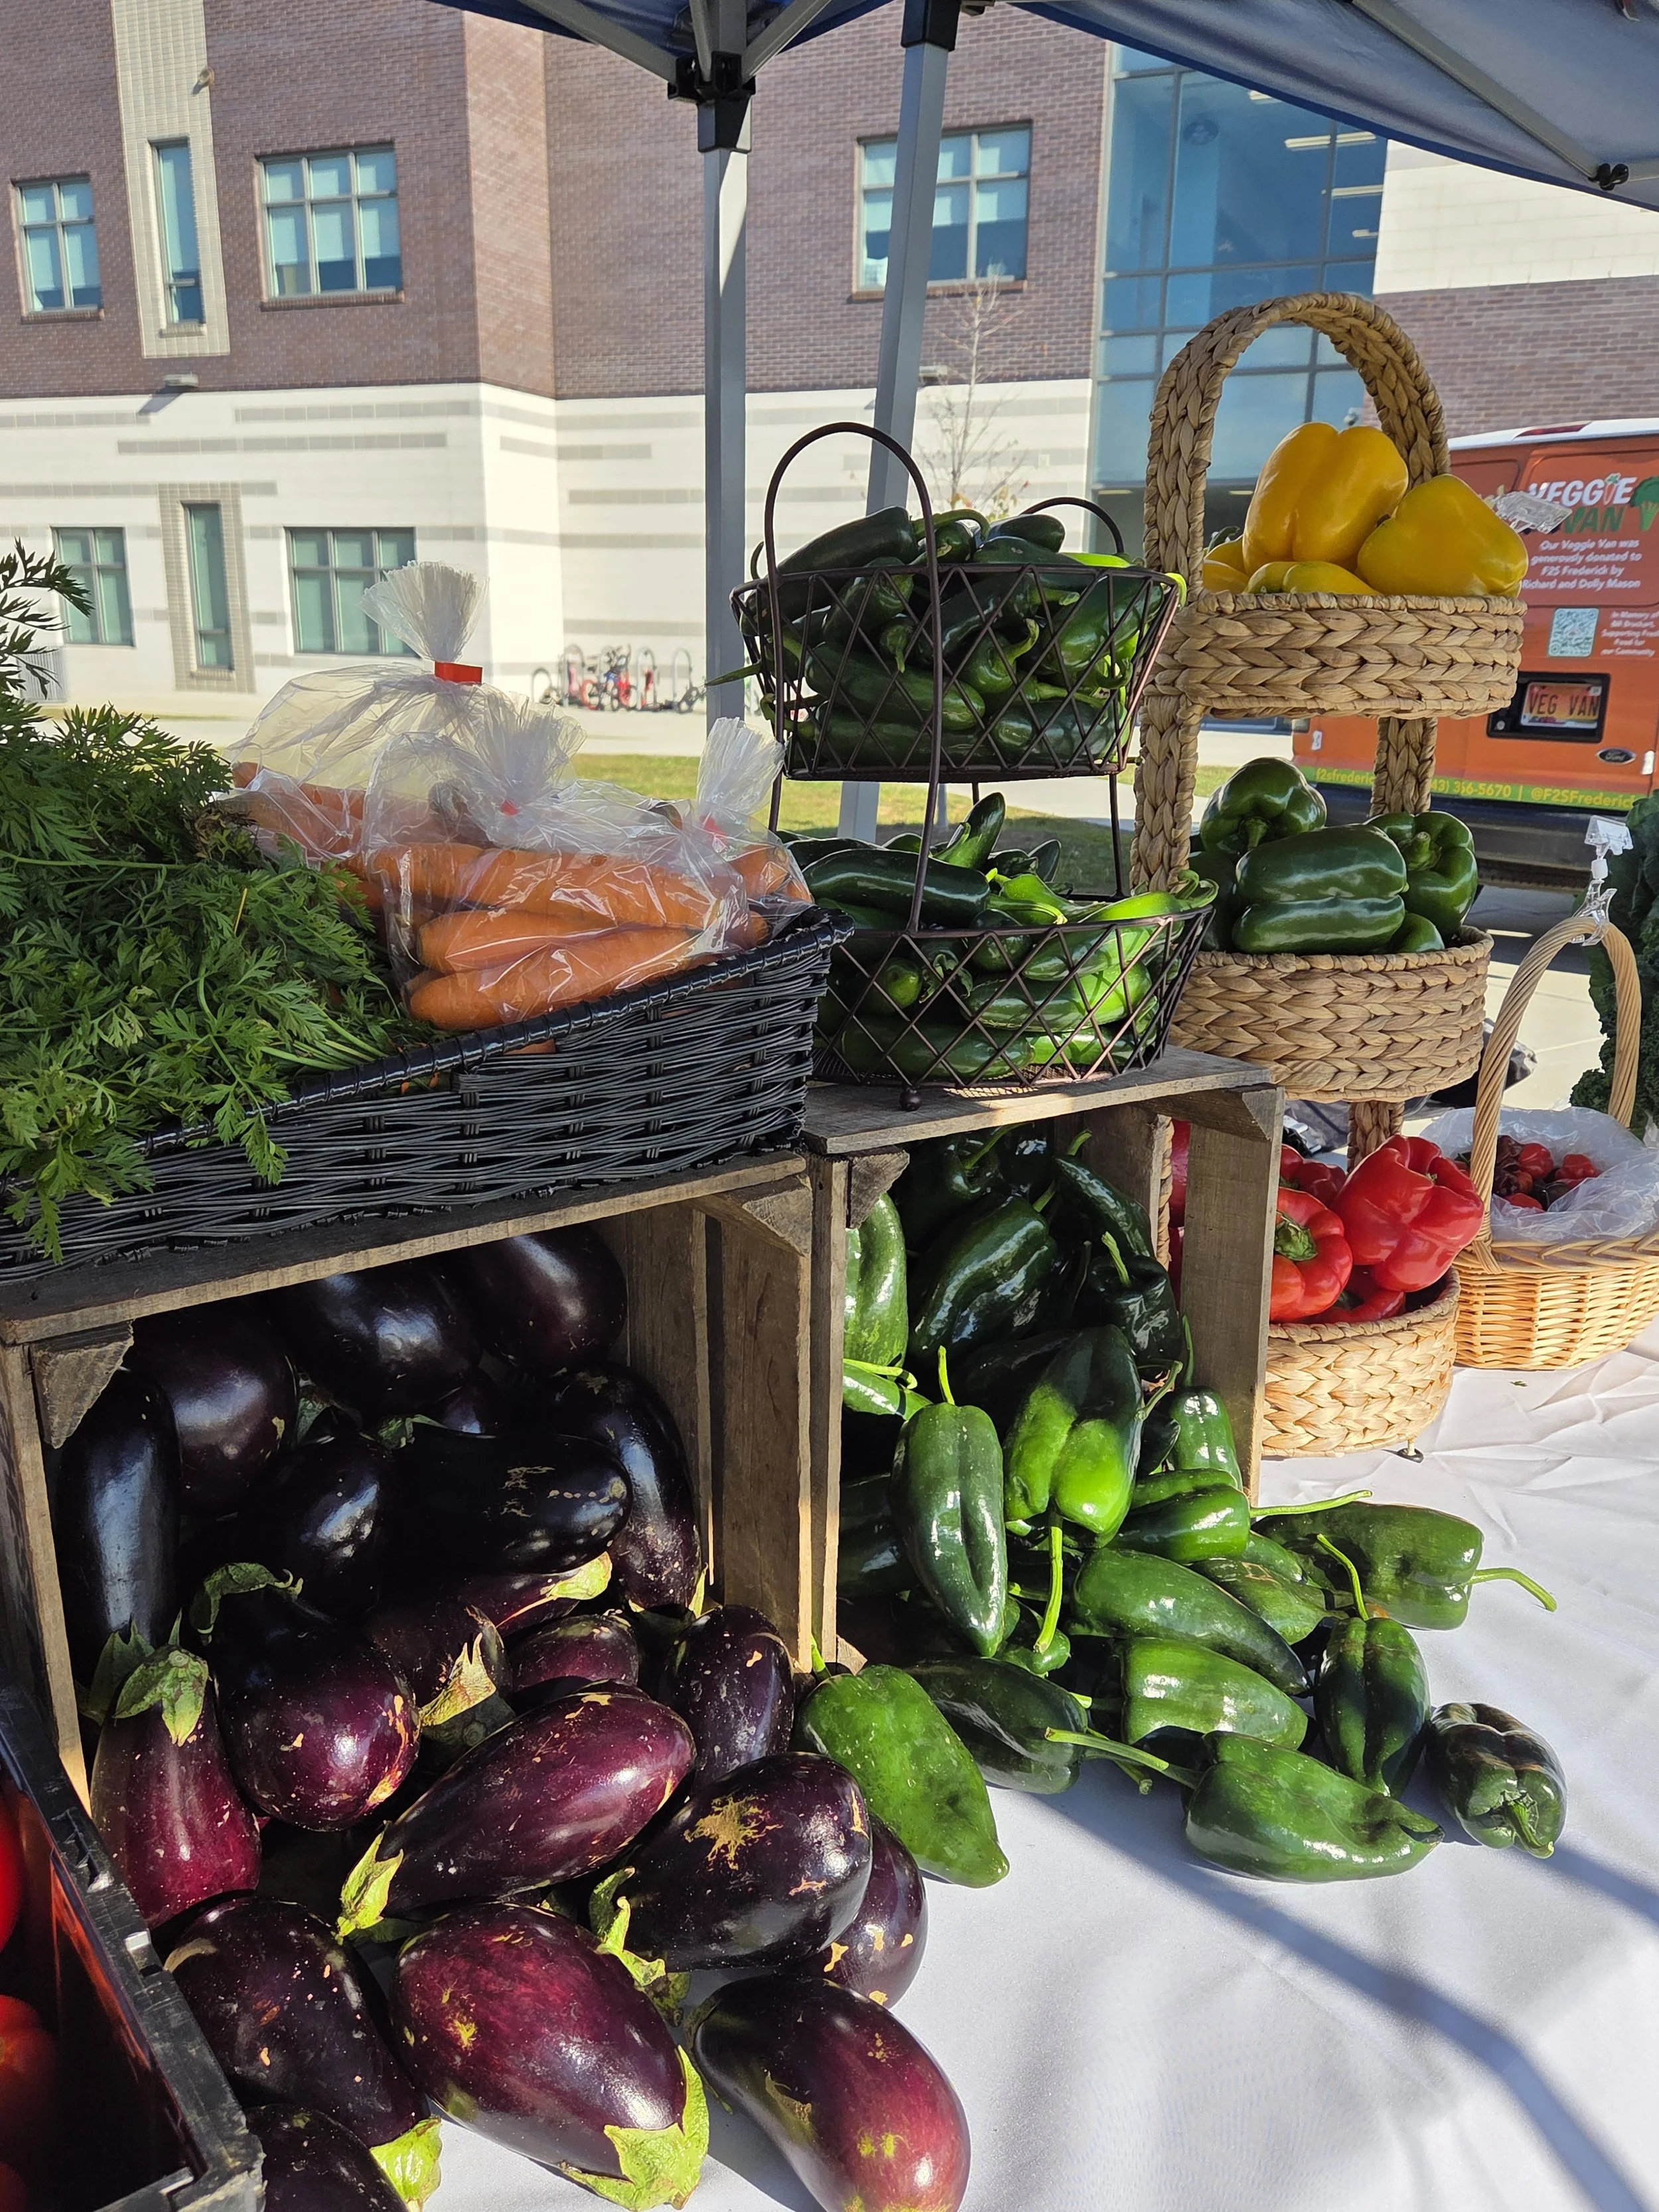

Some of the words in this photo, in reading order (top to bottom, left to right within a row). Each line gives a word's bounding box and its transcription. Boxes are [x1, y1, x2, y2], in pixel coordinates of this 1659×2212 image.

[1529, 474, 1637, 506] VEGGIE
[1563, 506, 1626, 534] VAN
[1539, 540, 1559, 551] Our
[1561, 539, 1595, 552] Veggie
[1597, 539, 1617, 549] Van
[1619, 540, 1640, 548] was
[1530, 553, 1584, 565] generously
[1585, 552, 1629, 562] donated
[1630, 552, 1642, 561] to
[1540, 565, 1560, 576] F2S
[1561, 565, 1609, 575] Frederick
[1610, 564, 1625, 577] by
[1522, 579, 1557, 589] Richard
[1558, 579, 1577, 589] and
[1578, 578, 1605, 591] Dolly
[1606, 579, 1641, 588] Mason
[1529, 692, 1559, 715] VEG
[1569, 694, 1600, 717] VAN
[1316, 768, 1376, 784] f2sfrederic
[1531, 787, 1635, 808] @F2SFrederic
